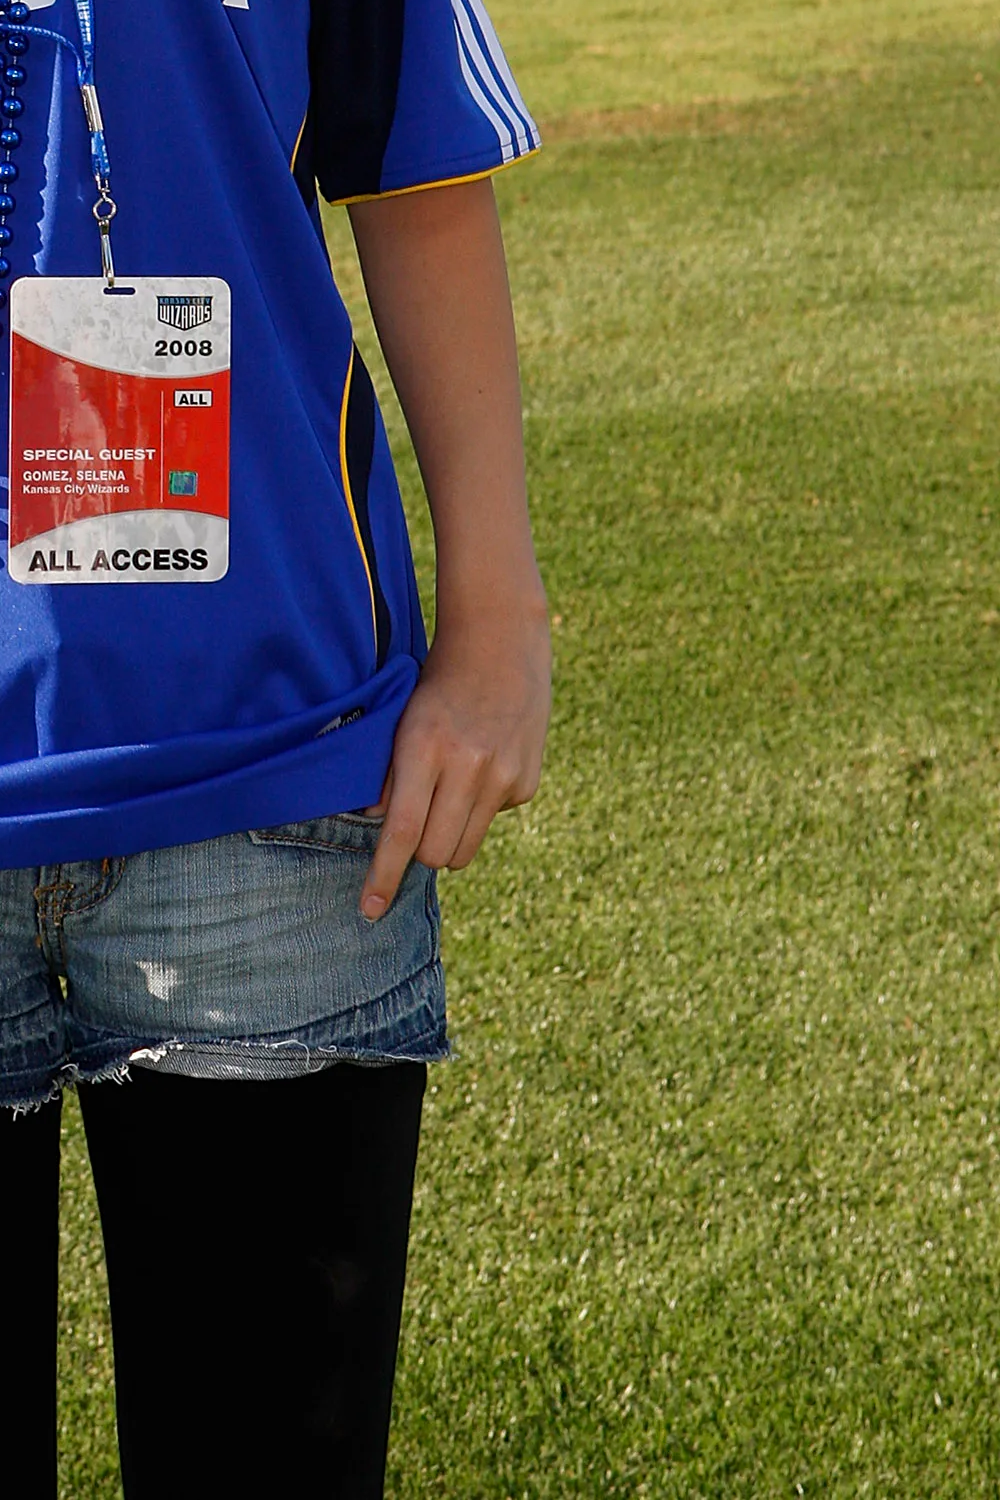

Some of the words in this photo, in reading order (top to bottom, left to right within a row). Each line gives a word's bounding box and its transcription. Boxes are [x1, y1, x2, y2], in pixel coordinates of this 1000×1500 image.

[159, 304, 211, 329] WIZARDS
[154, 339, 213, 357] 2008
[178, 393, 207, 405] ALL
[22, 449, 95, 462] SPECIAL
[98, 449, 156, 461] GUEST
[22, 470, 73, 483] GOMEZ,
[76, 470, 126, 482] SELENA
[22, 484, 61, 494] Kansas
[63, 484, 85, 496] City
[87, 484, 130, 494] Wizards
[27, 550, 82, 573] ALL
[91, 548, 209, 572] ACCESS
